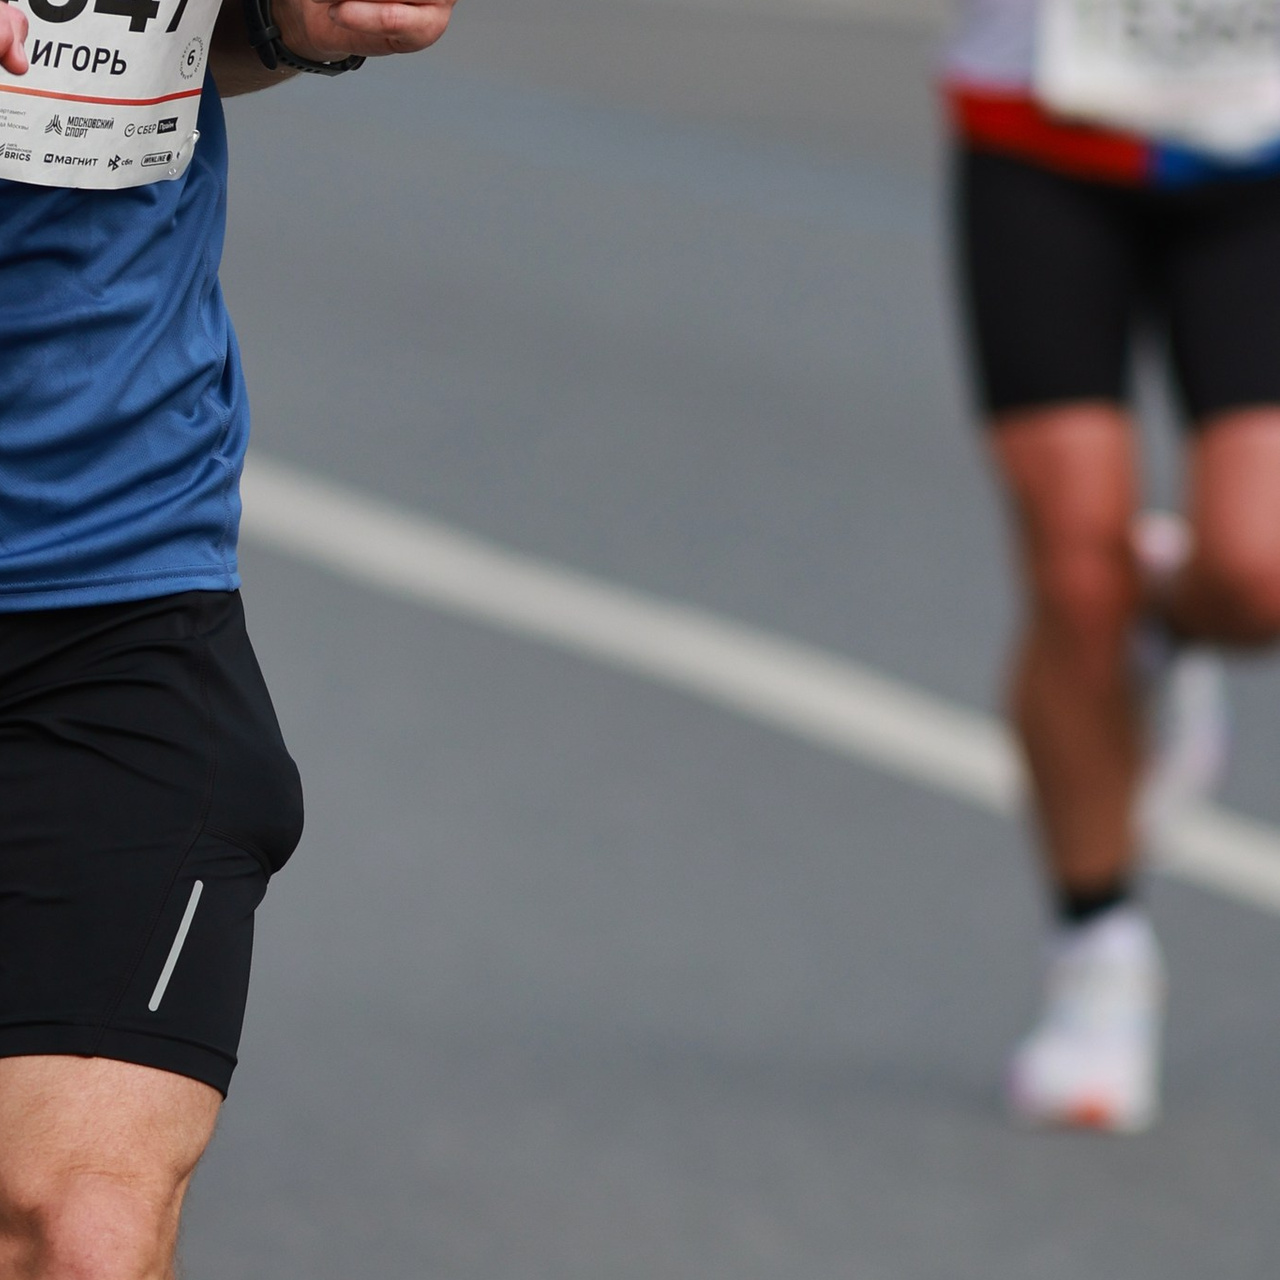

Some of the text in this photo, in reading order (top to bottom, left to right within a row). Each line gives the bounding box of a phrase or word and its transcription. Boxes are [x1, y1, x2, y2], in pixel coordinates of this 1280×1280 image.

[30, 39, 128, 76] ИГОРЬ
[187, 49, 196, 66] 6
[66, 116, 115, 130] МОСКОВСКИЙ
[137, 123, 157, 135] СБЕР
[64, 127, 88, 138] СПОРТ
[4, 150, 31, 162] BRICS
